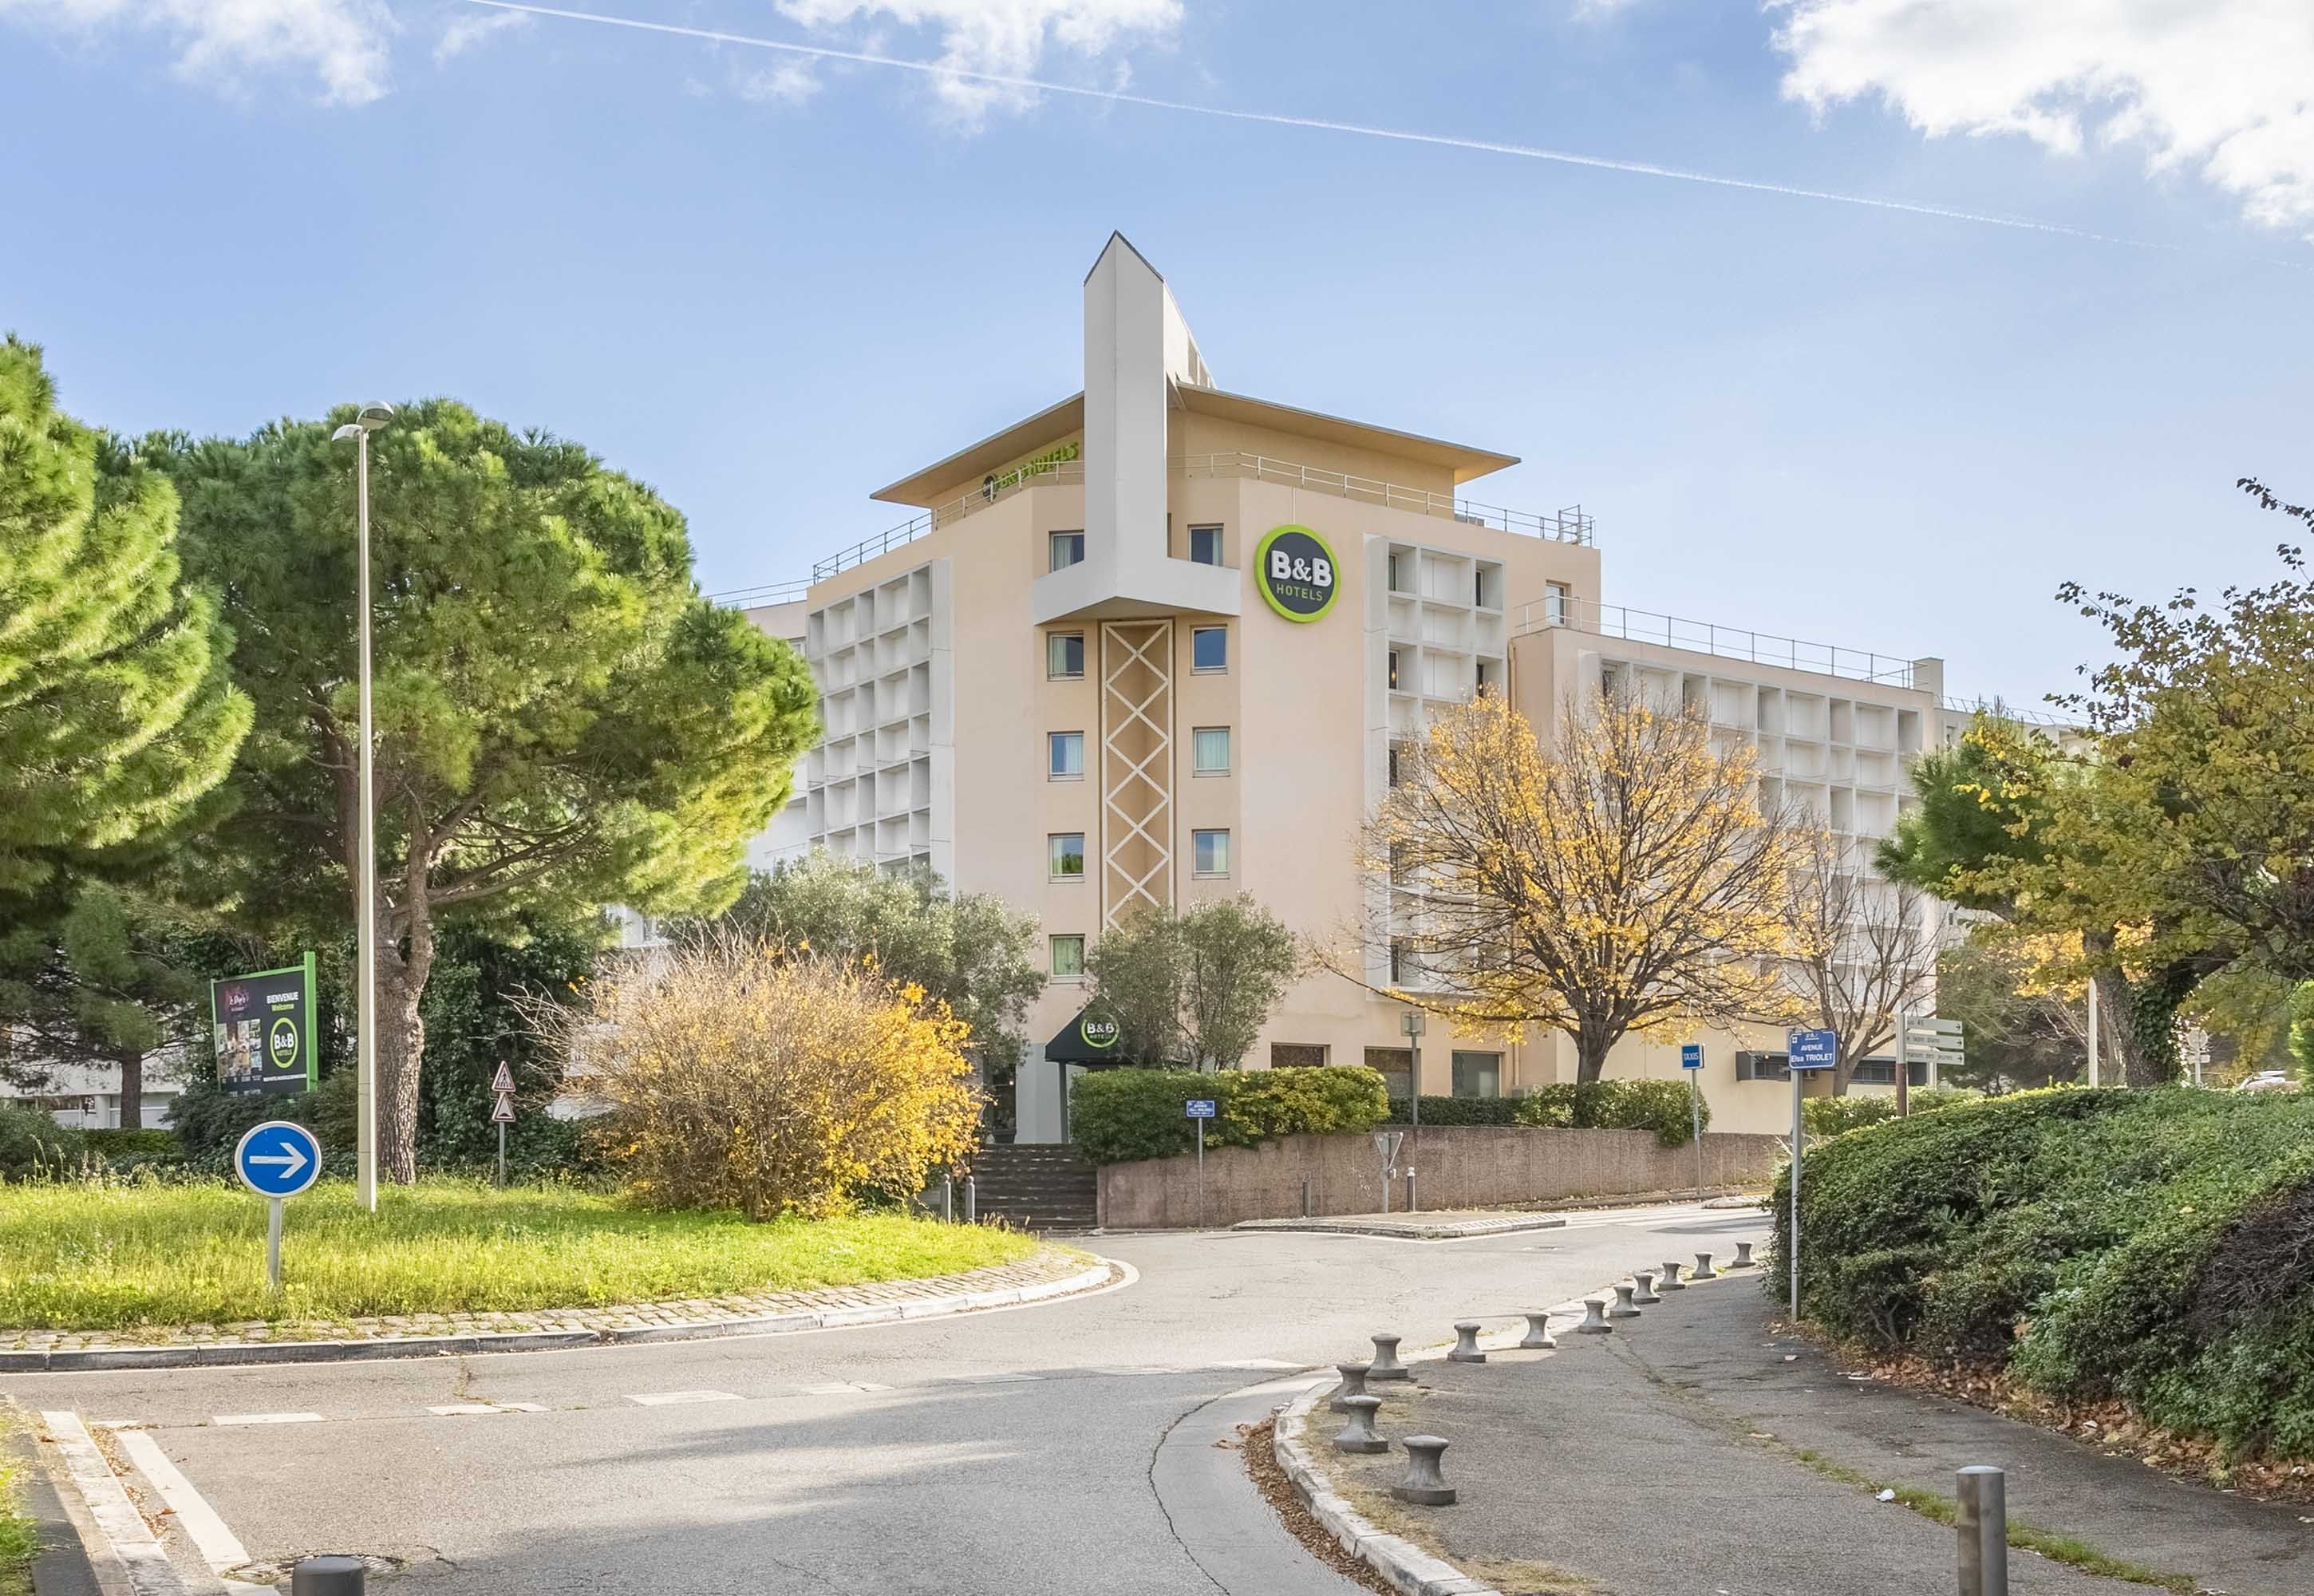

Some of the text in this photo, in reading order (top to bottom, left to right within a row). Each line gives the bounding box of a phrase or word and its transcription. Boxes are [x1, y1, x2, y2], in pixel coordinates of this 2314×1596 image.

[1270, 550, 1333, 587] B&B
[1276, 583, 1324, 602] HOTELS
[266, 991, 299, 1004] BIENVENUE
[1087, 1022, 1115, 1034] B&B
[274, 1033, 294, 1050] B&B
[275, 1049, 293, 1057] HOTELS
